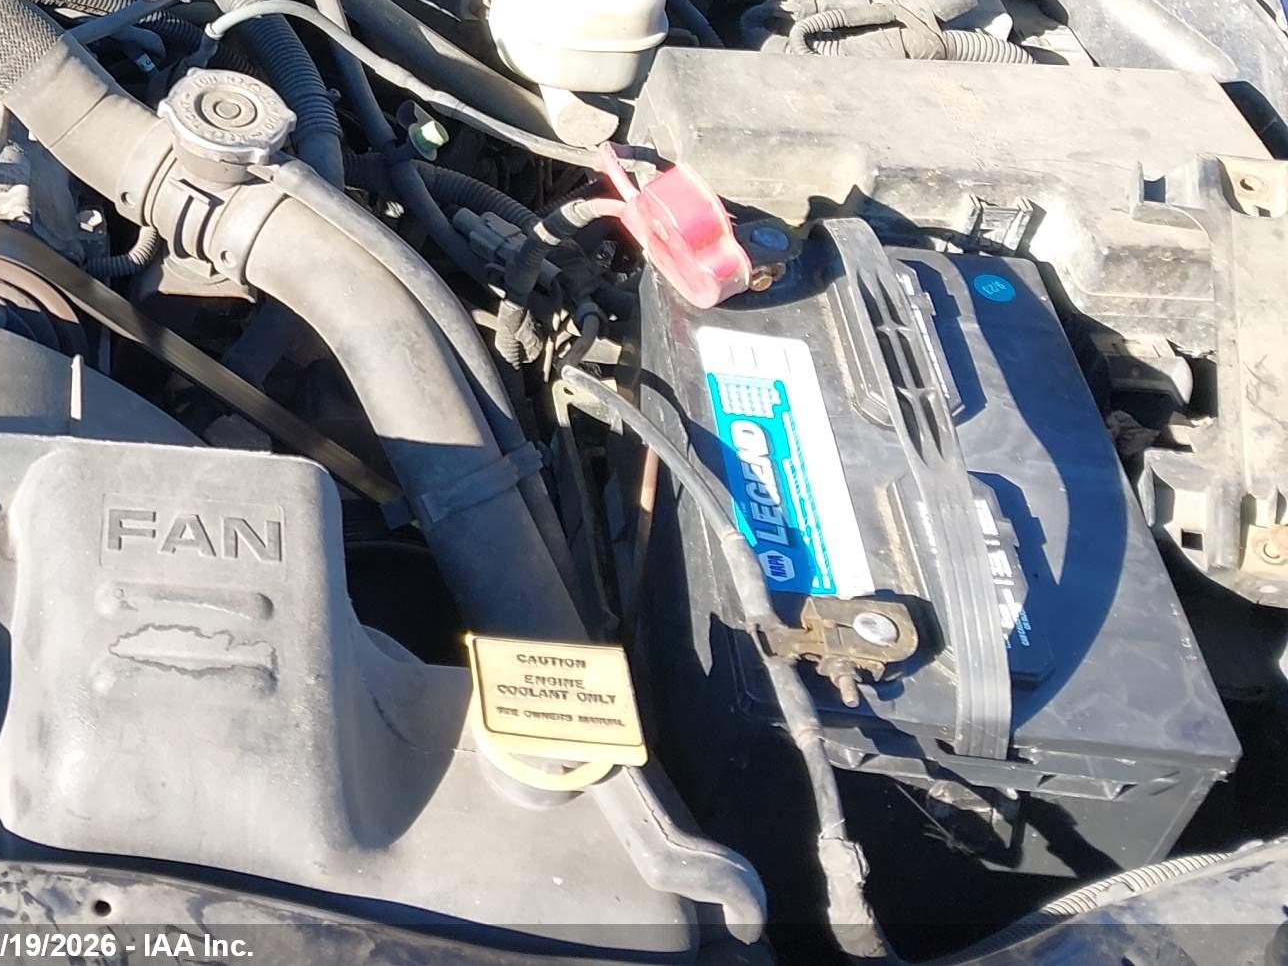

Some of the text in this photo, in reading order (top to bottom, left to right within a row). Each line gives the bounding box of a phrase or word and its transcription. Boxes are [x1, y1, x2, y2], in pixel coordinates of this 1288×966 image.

[730, 420, 790, 546] LEGEND
[107, 509, 282, 562] FAN
[767, 554, 788, 578] NAPA
[516, 654, 586, 668] CAUTION
[524, 675, 584, 689] ENGINE
[497, 684, 616, 704] COOLANT ONLY
